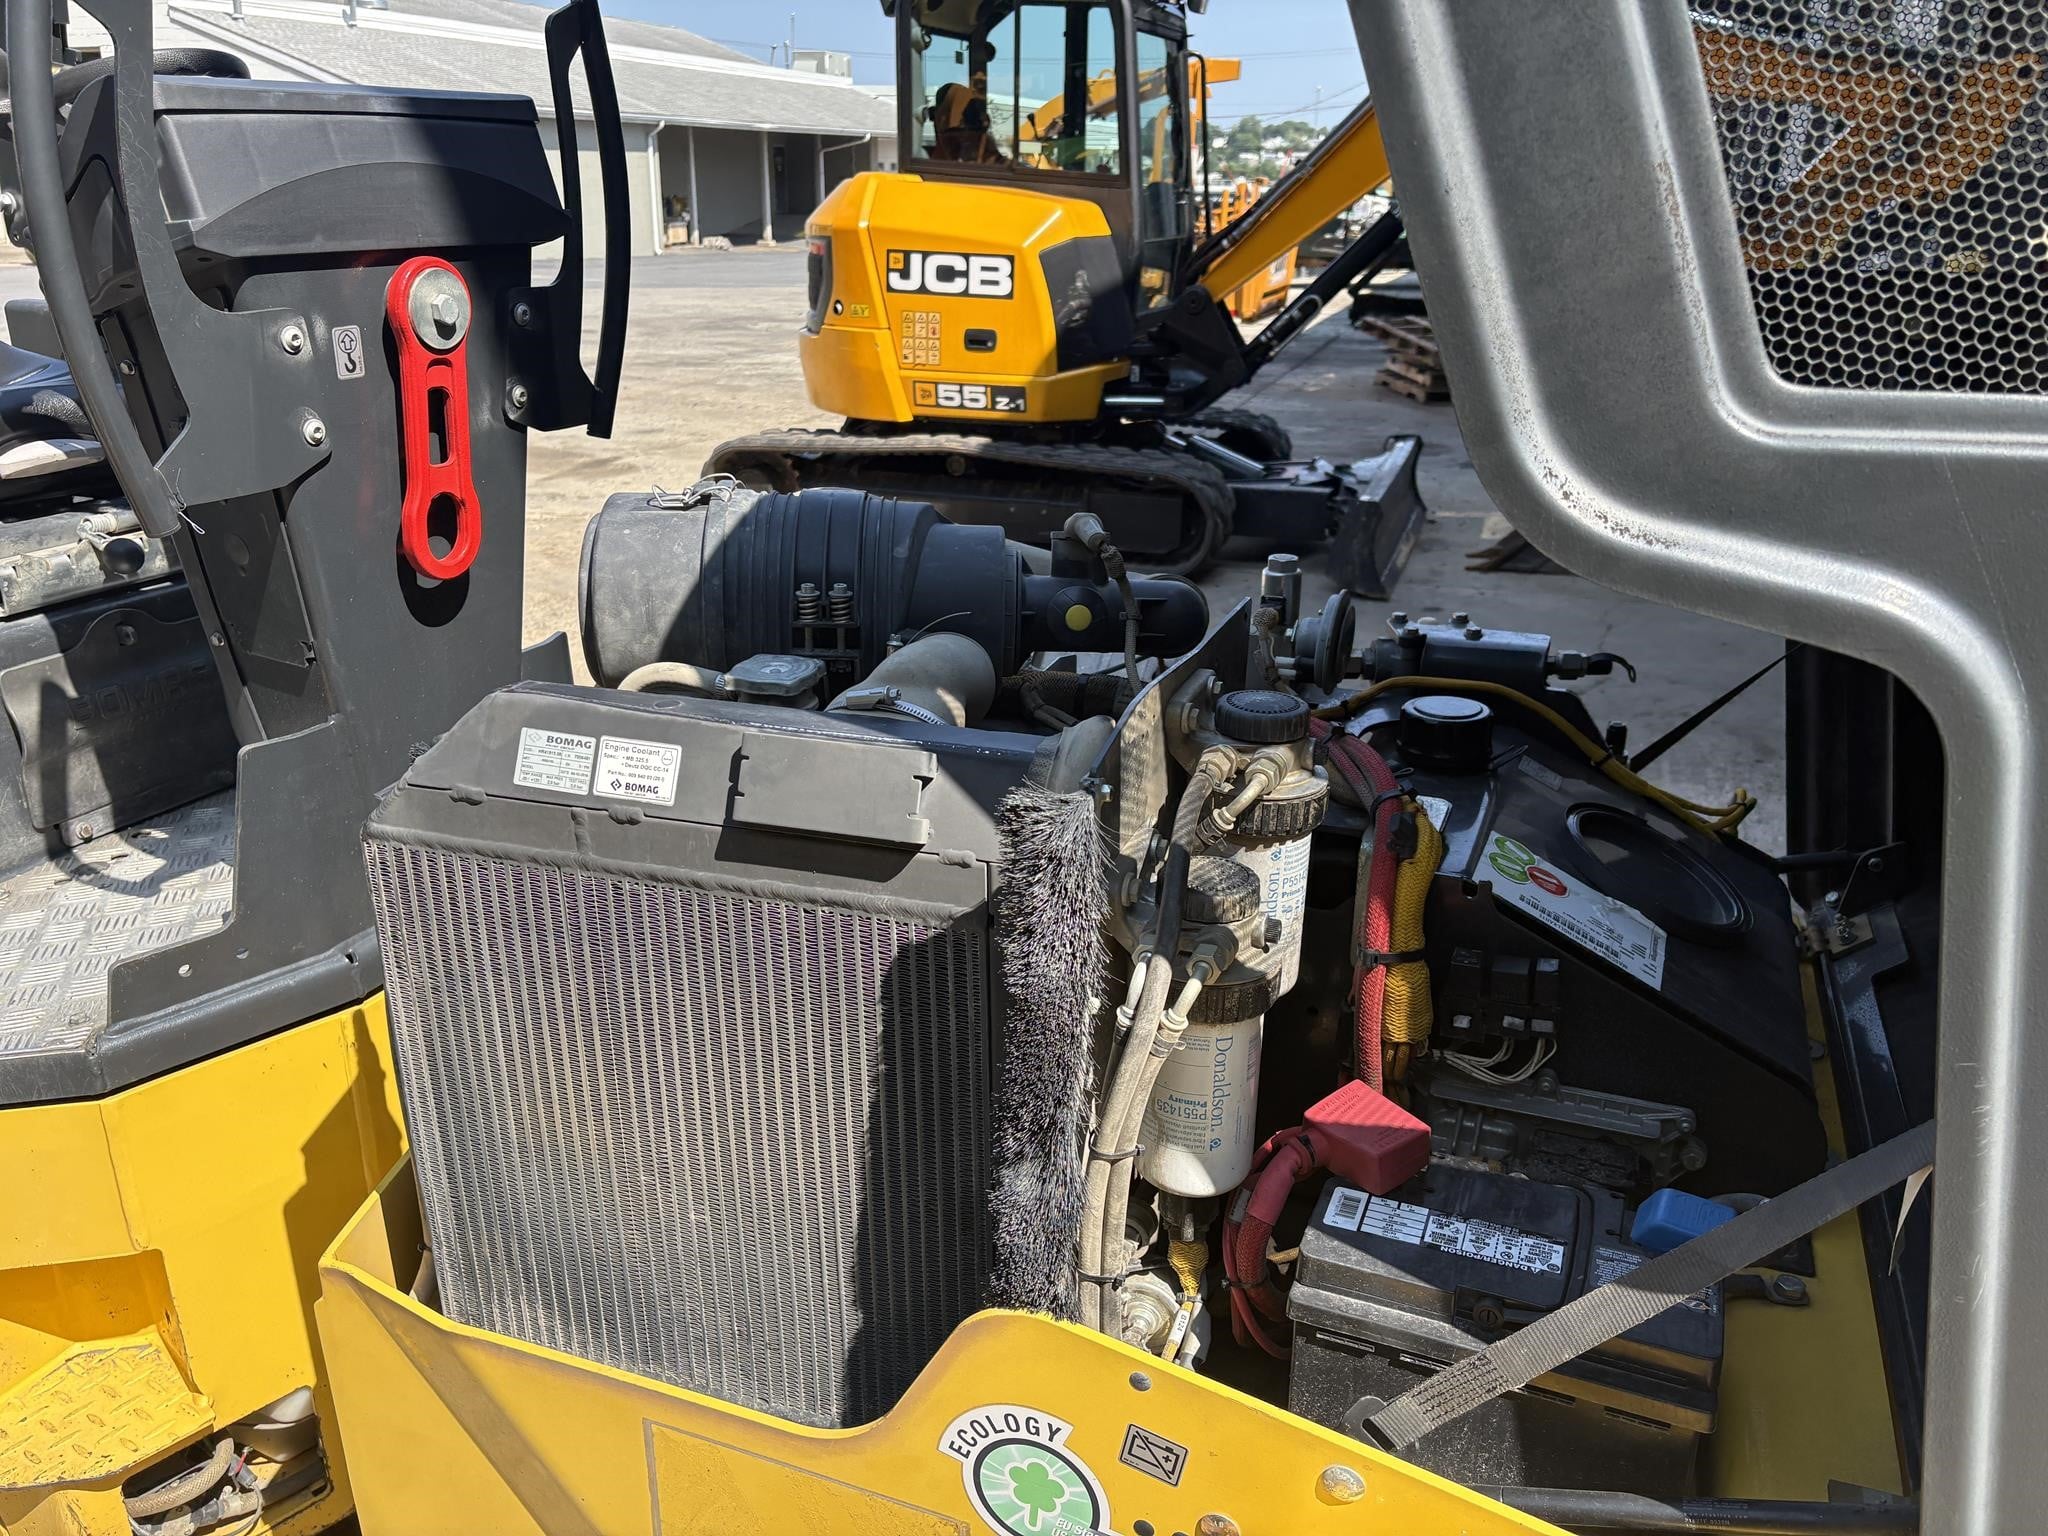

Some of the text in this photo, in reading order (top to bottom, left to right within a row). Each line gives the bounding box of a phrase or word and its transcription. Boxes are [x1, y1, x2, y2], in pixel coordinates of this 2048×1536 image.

[888, 253, 1012, 296] JCB
[937, 383, 1025, 411] 55 Z-1
[546, 735, 592, 749] BOMAG
[604, 743, 660, 756] Engine Coolant
[625, 782, 659, 794] BOMAG
[1260, 872, 1281, 918] ldson
[1211, 1036, 1233, 1128] Donaldson
[1157, 1099, 1207, 1120] P551435
[1168, 1094, 1207, 1108] Primary
[1440, 1246, 1528, 1271] DANGER/POISON
[949, 1413, 1061, 1459] ECOLOGY
[1056, 1518, 1073, 1531] EU
